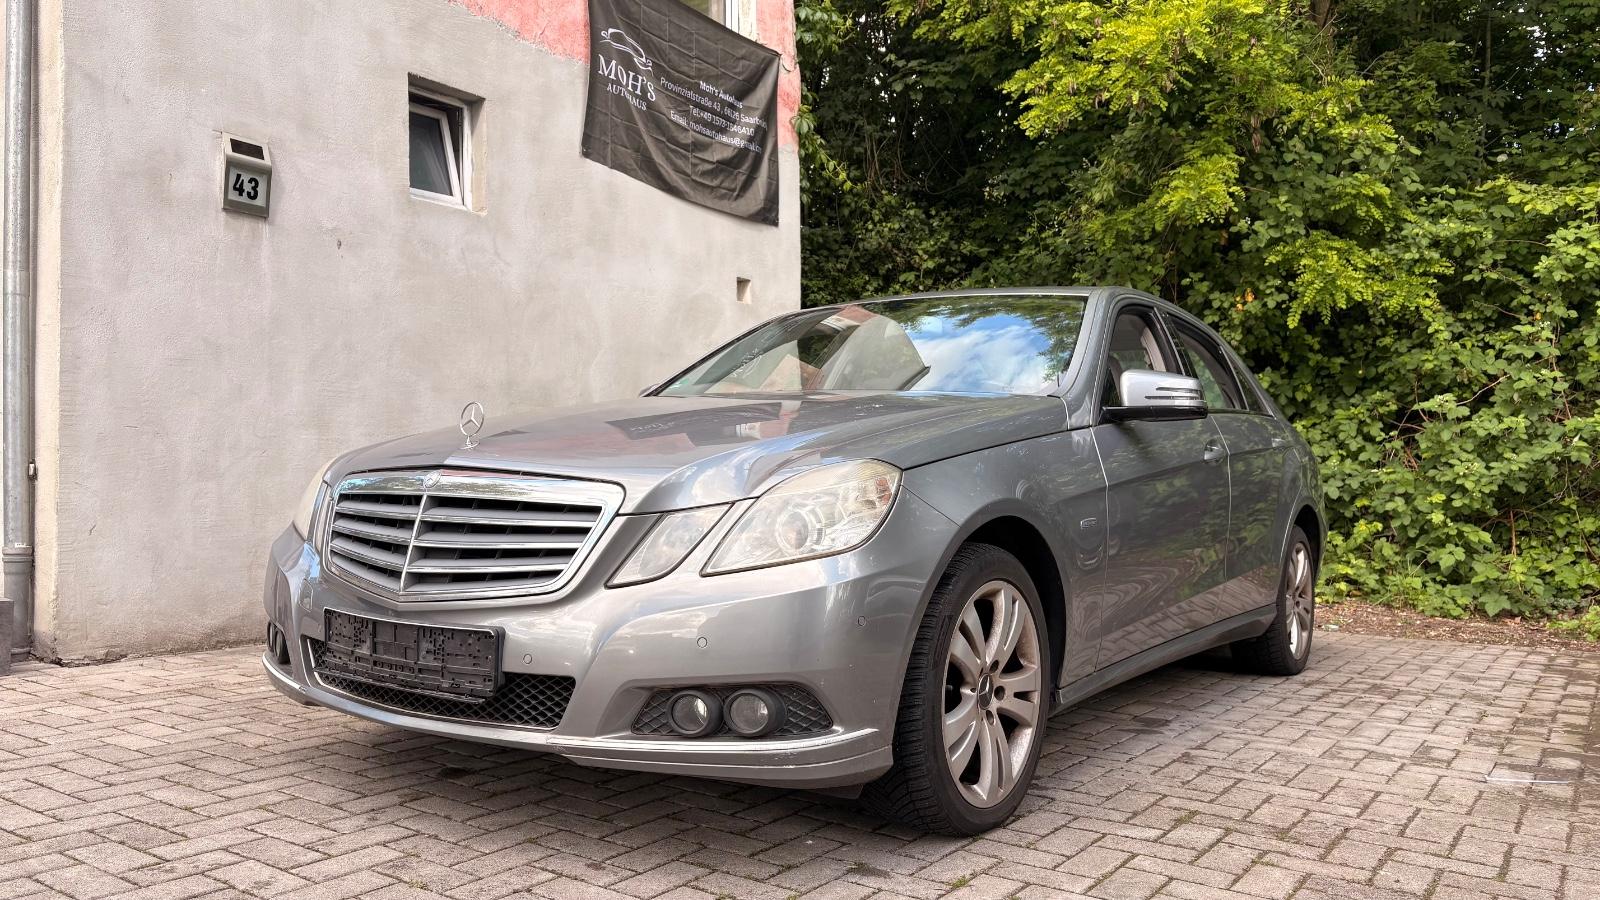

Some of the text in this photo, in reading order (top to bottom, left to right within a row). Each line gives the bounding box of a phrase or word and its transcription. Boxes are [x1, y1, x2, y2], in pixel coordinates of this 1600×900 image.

[597, 53, 656, 102] MOH'S
[660, 76, 713, 108] Provinzialstraße
[606, 82, 647, 111] AUTOHAUS
[699, 80, 743, 109] Moh's Autohaus
[670, 110, 688, 127] Email:
[232, 172, 260, 201] 43
